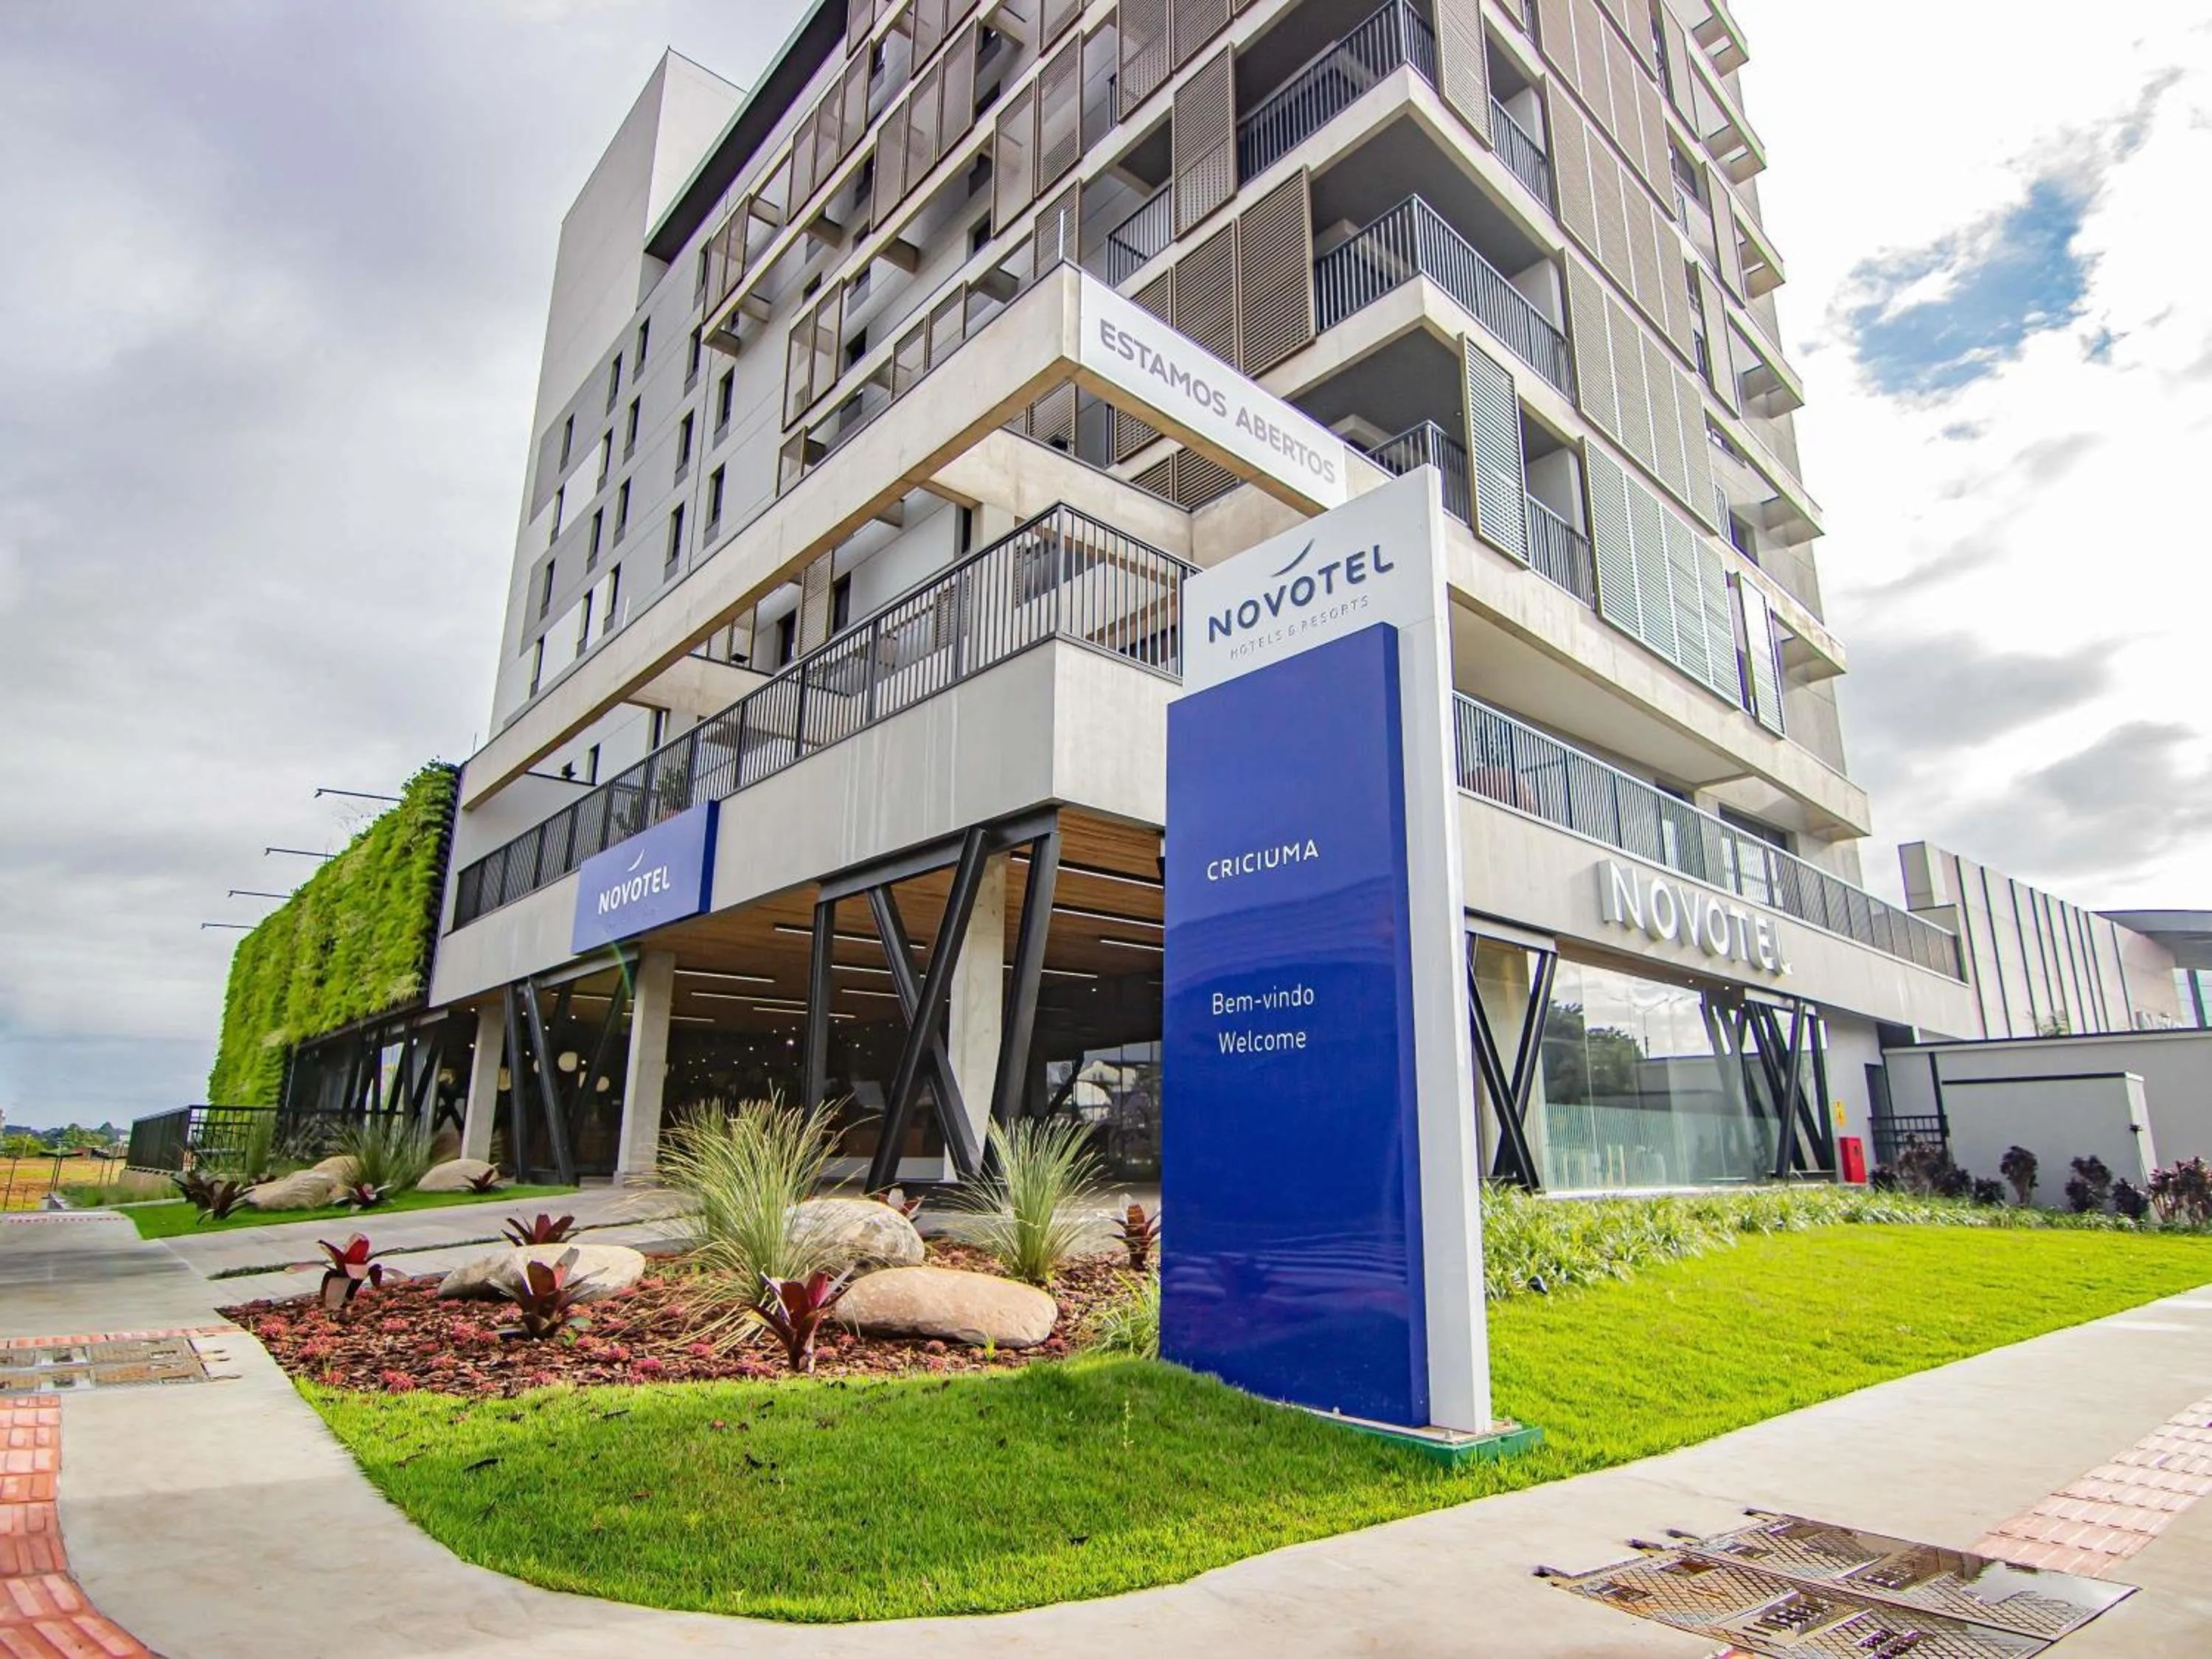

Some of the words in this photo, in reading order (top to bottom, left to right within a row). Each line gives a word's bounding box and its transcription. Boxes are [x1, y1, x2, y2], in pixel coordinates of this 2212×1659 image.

[1099, 319, 1228, 418] ESTAMOS
[1235, 406, 1336, 484] ABERTOS
[1208, 544, 1394, 644] NOVOTEL
[1230, 630, 1283, 660] HOTELS
[1301, 595, 1369, 632] RESORTS
[1207, 838, 1319, 881] CRICIUMA
[598, 865, 670, 915] NOVOTEL
[1597, 859, 1793, 976] NOVOTEL
[1211, 983, 1315, 1015] Bem-vindo
[1219, 1030, 1307, 1055] Welcome
